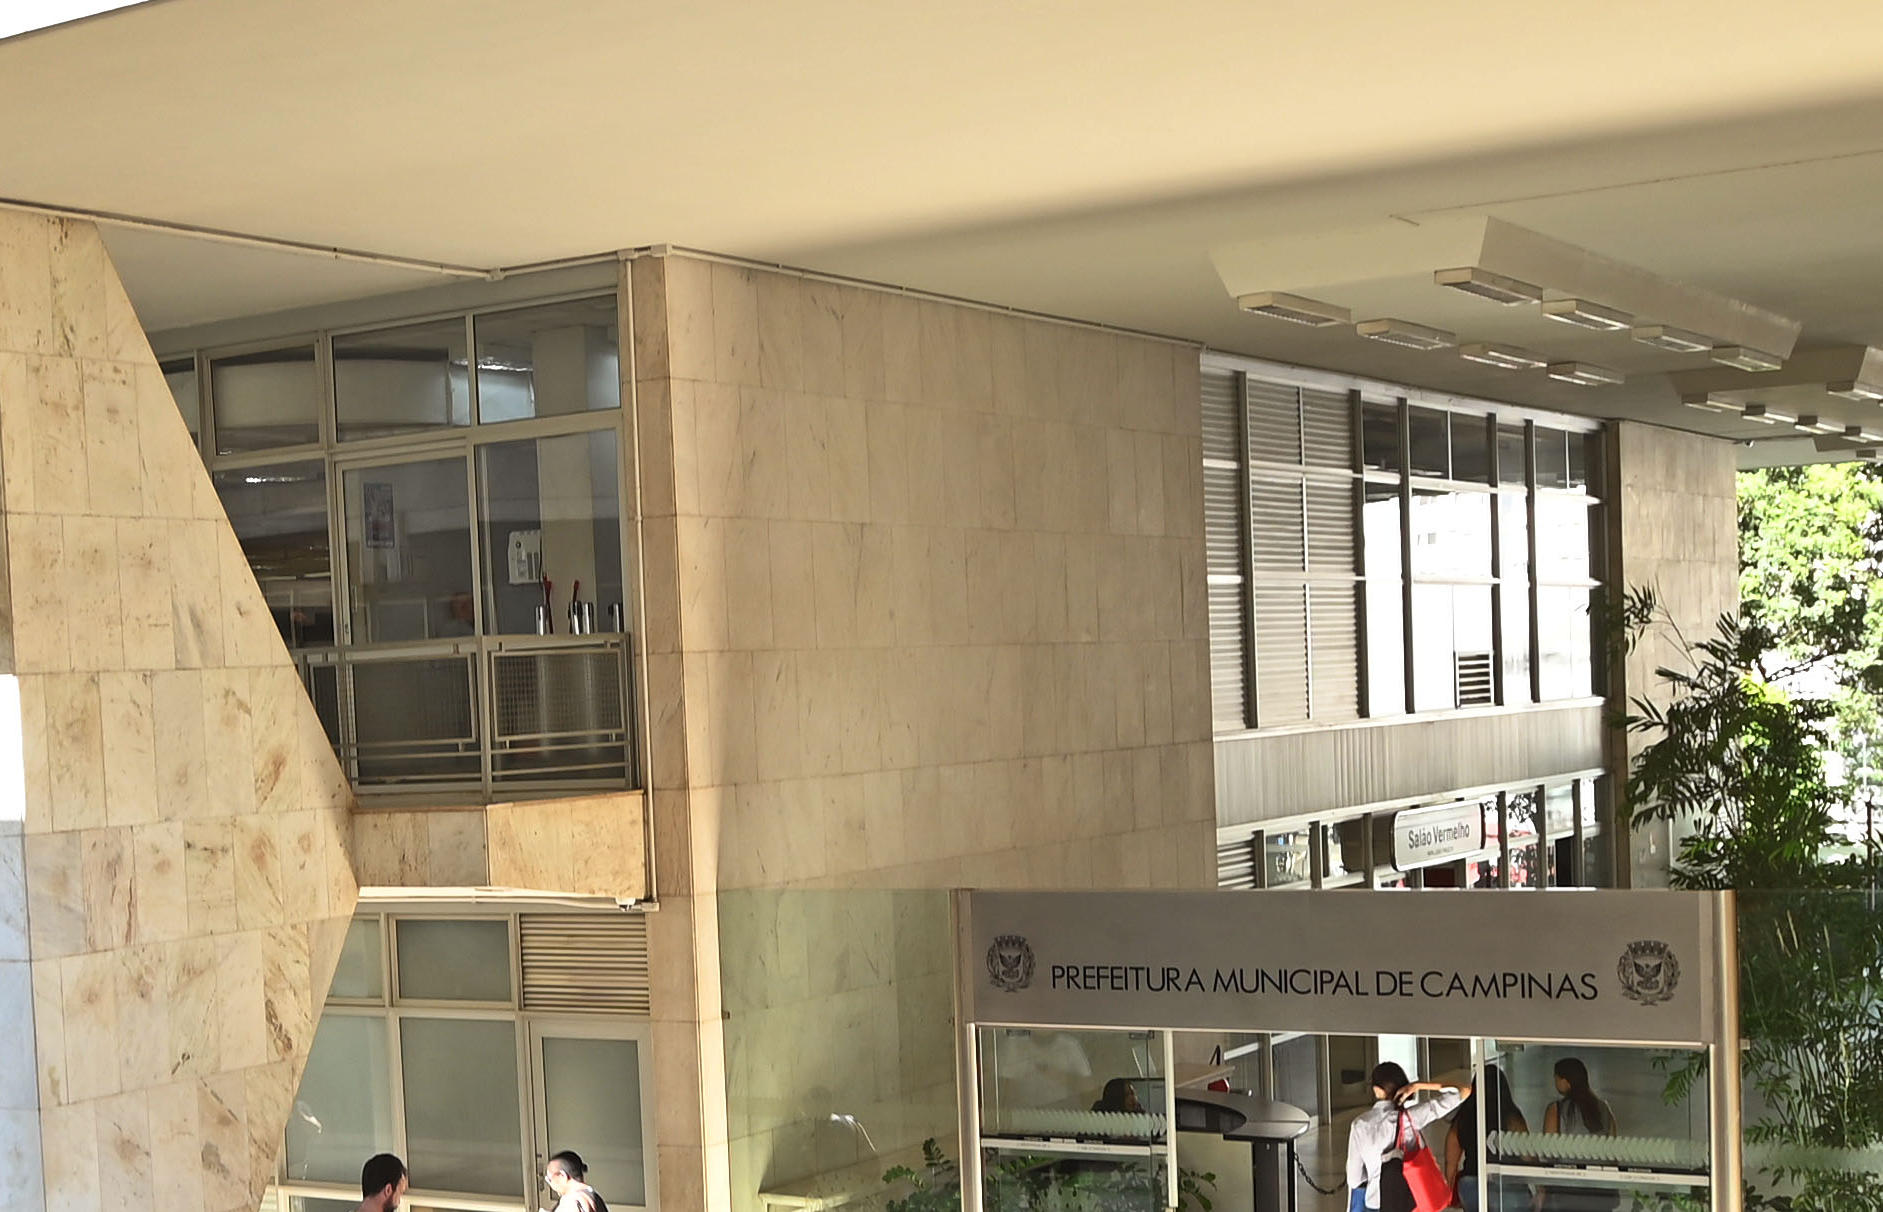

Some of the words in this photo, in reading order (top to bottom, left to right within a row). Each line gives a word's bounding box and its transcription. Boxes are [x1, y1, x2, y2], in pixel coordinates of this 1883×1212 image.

[1408, 827, 1432, 849] Salão
[1433, 823, 1470, 844] Vermelho
[1051, 965, 1206, 993] PREFEITURA
[1212, 967, 1369, 996] MUNICIPAL
[1375, 970, 1414, 997] DE
[1420, 971, 1598, 1001] CAMPINAS
